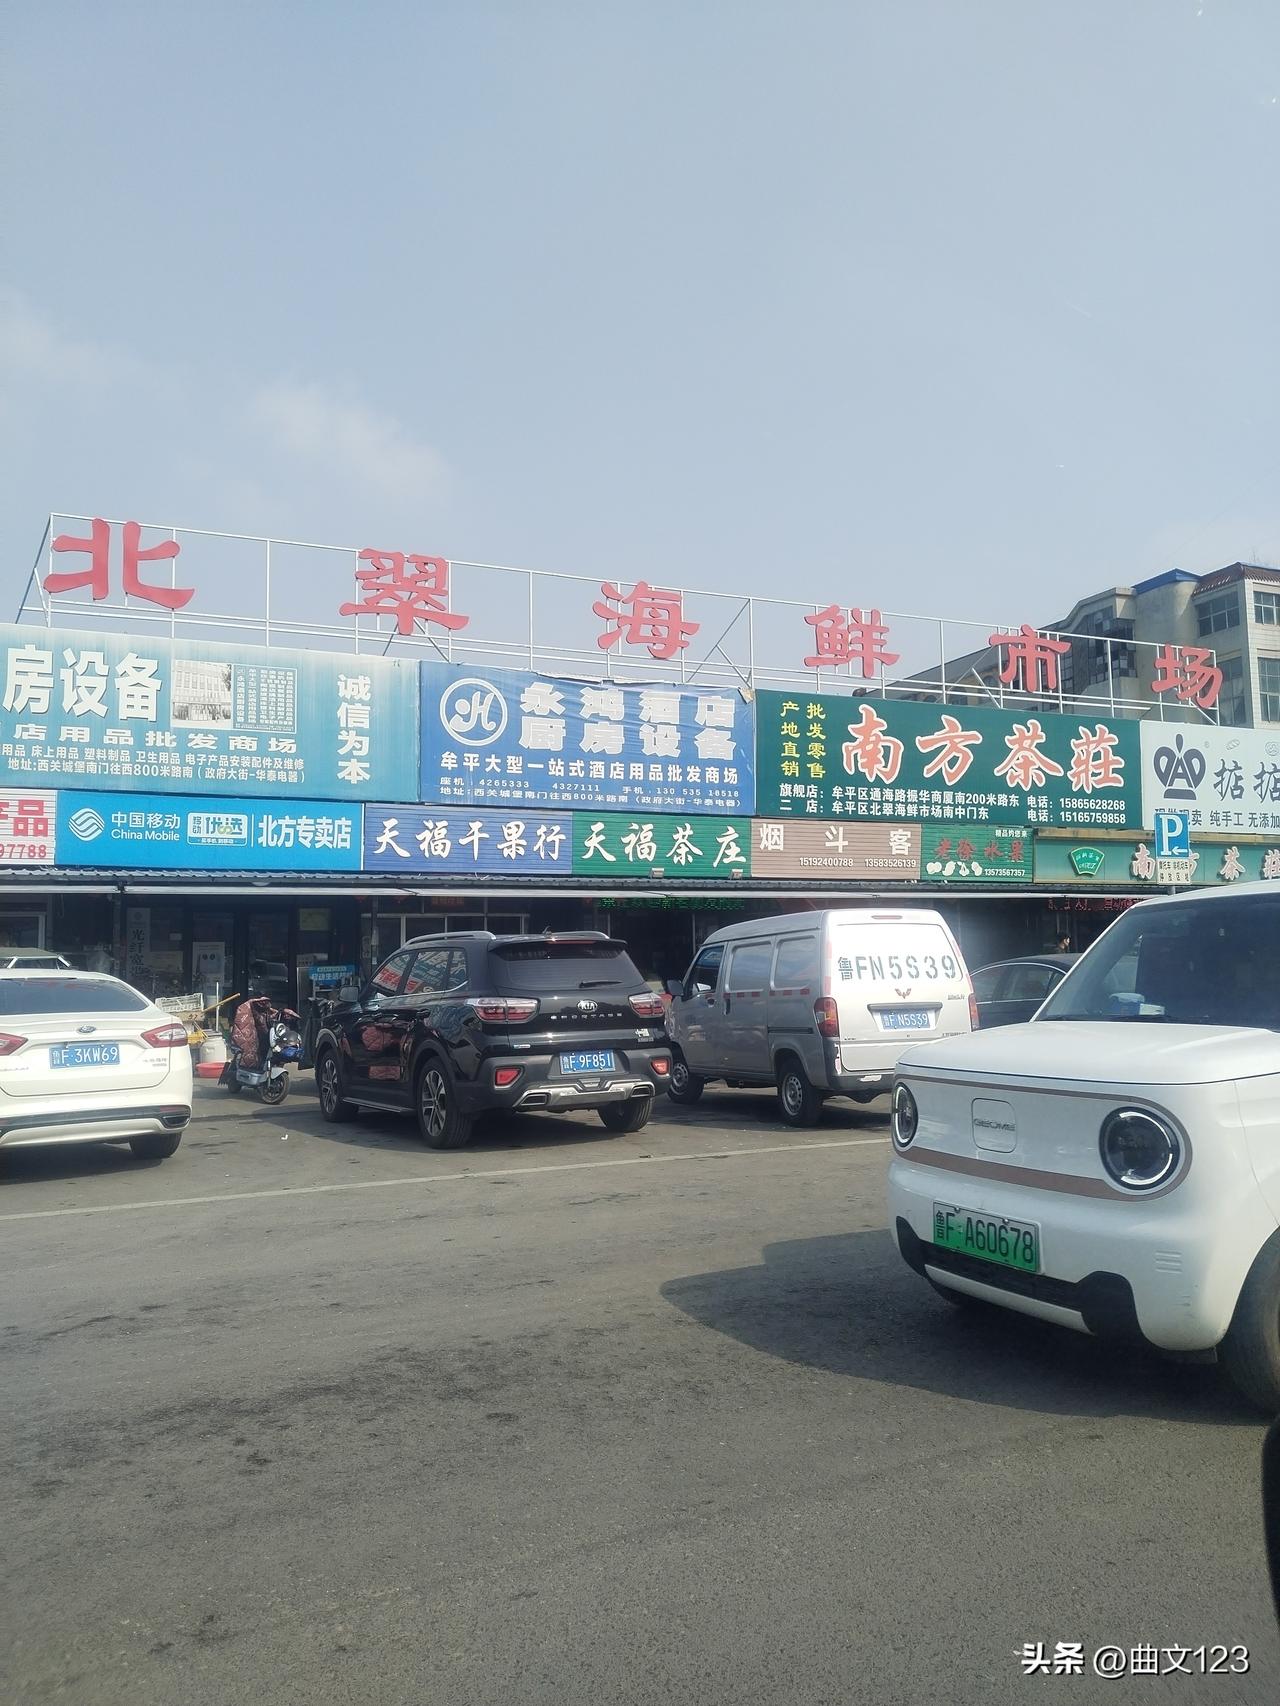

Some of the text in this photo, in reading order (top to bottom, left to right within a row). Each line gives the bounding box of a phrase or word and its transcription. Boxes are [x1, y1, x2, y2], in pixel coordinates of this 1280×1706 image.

[43, 517, 1223, 709] 北翠海鲜市场
[2, 644, 162, 723] 房设备
[519, 682, 736, 728] 永鸿酒店
[13, 723, 298, 754] 店用品批发商场
[337, 674, 371, 784] 诚信为本
[518, 716, 736, 760] 厨房设备
[780, 701, 800, 777] 产地直销
[807, 702, 827, 779] 批发零售
[136, 750, 180, 765] 卫生用品
[440, 751, 738, 785] 牟平大型一站式酒店用品批发商场
[111, 811, 181, 830] 中国移动
[111, 828, 180, 842] China Mobile
[258, 814, 352, 849] 北方专卖店
[1158, 814, 1184, 857] P
[1209, 810, 1244, 827] 纯手工
[374, 817, 566, 862] 天福干果行
[581, 821, 747, 868] 天福茶庄
[759, 823, 912, 856] 烟斗客
[800, 857, 917, 868] 15192400788 13583526139
[837, 955, 957, 981] 鲁FN5S39
